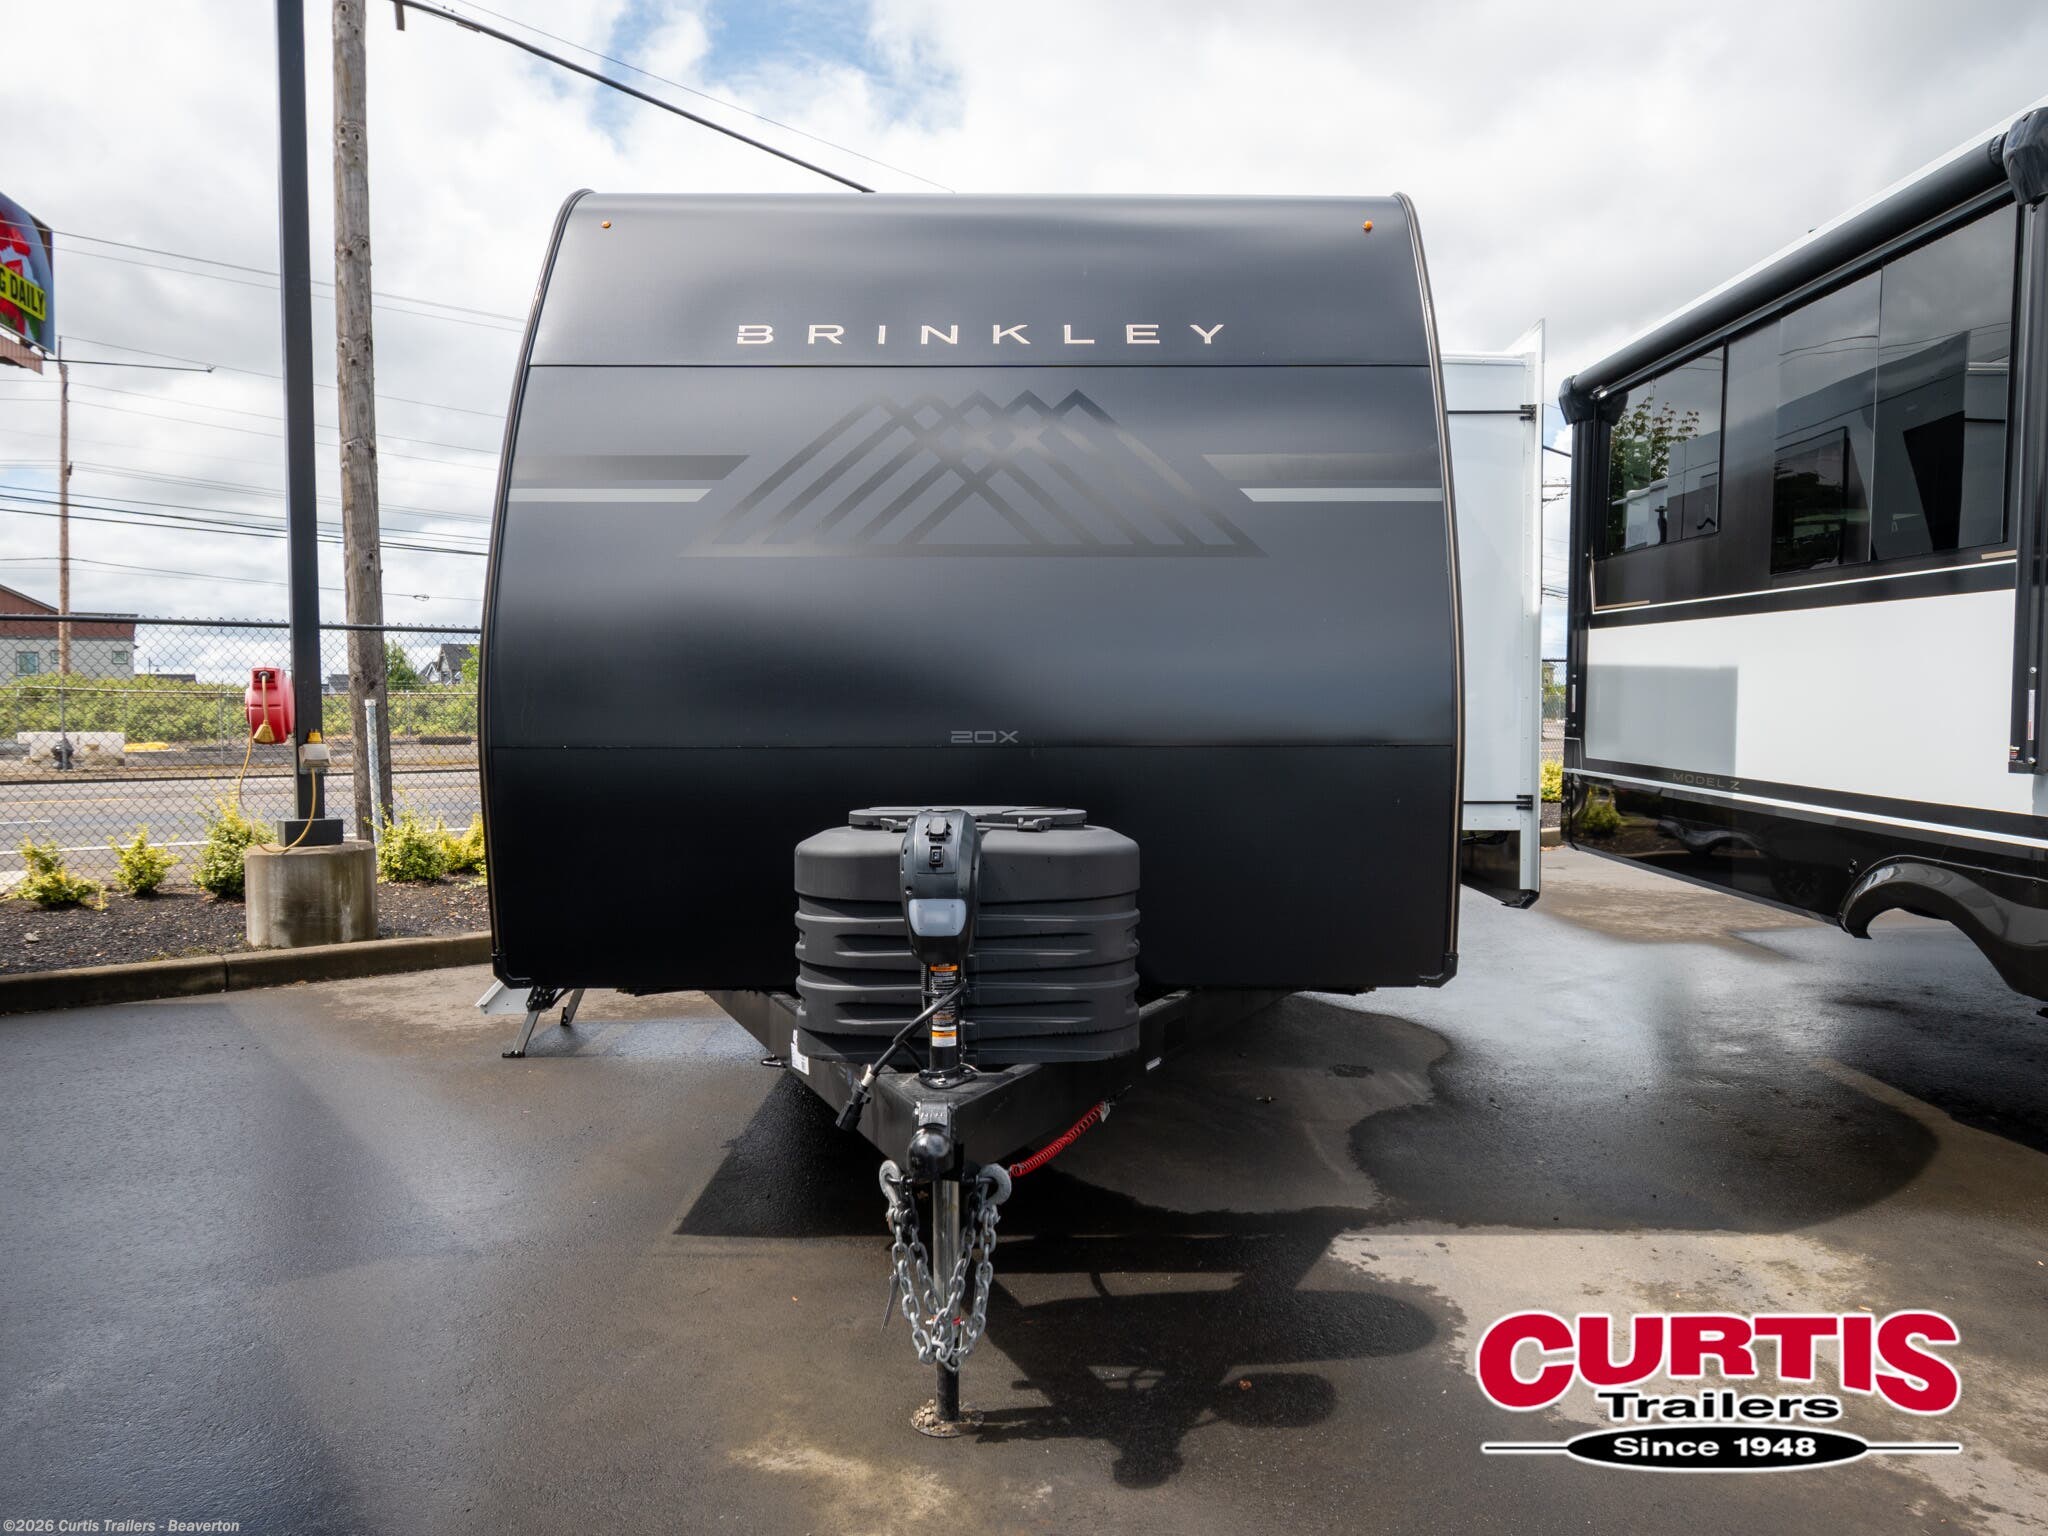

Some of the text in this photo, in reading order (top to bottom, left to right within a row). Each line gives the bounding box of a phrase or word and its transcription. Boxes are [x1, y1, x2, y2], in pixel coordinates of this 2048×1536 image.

[10, 273, 45, 315] DAILY
[737, 324, 1225, 345] BRINKLEY
[950, 730, 1019, 744] 20X
[1672, 773, 1741, 791] MODEL Z
